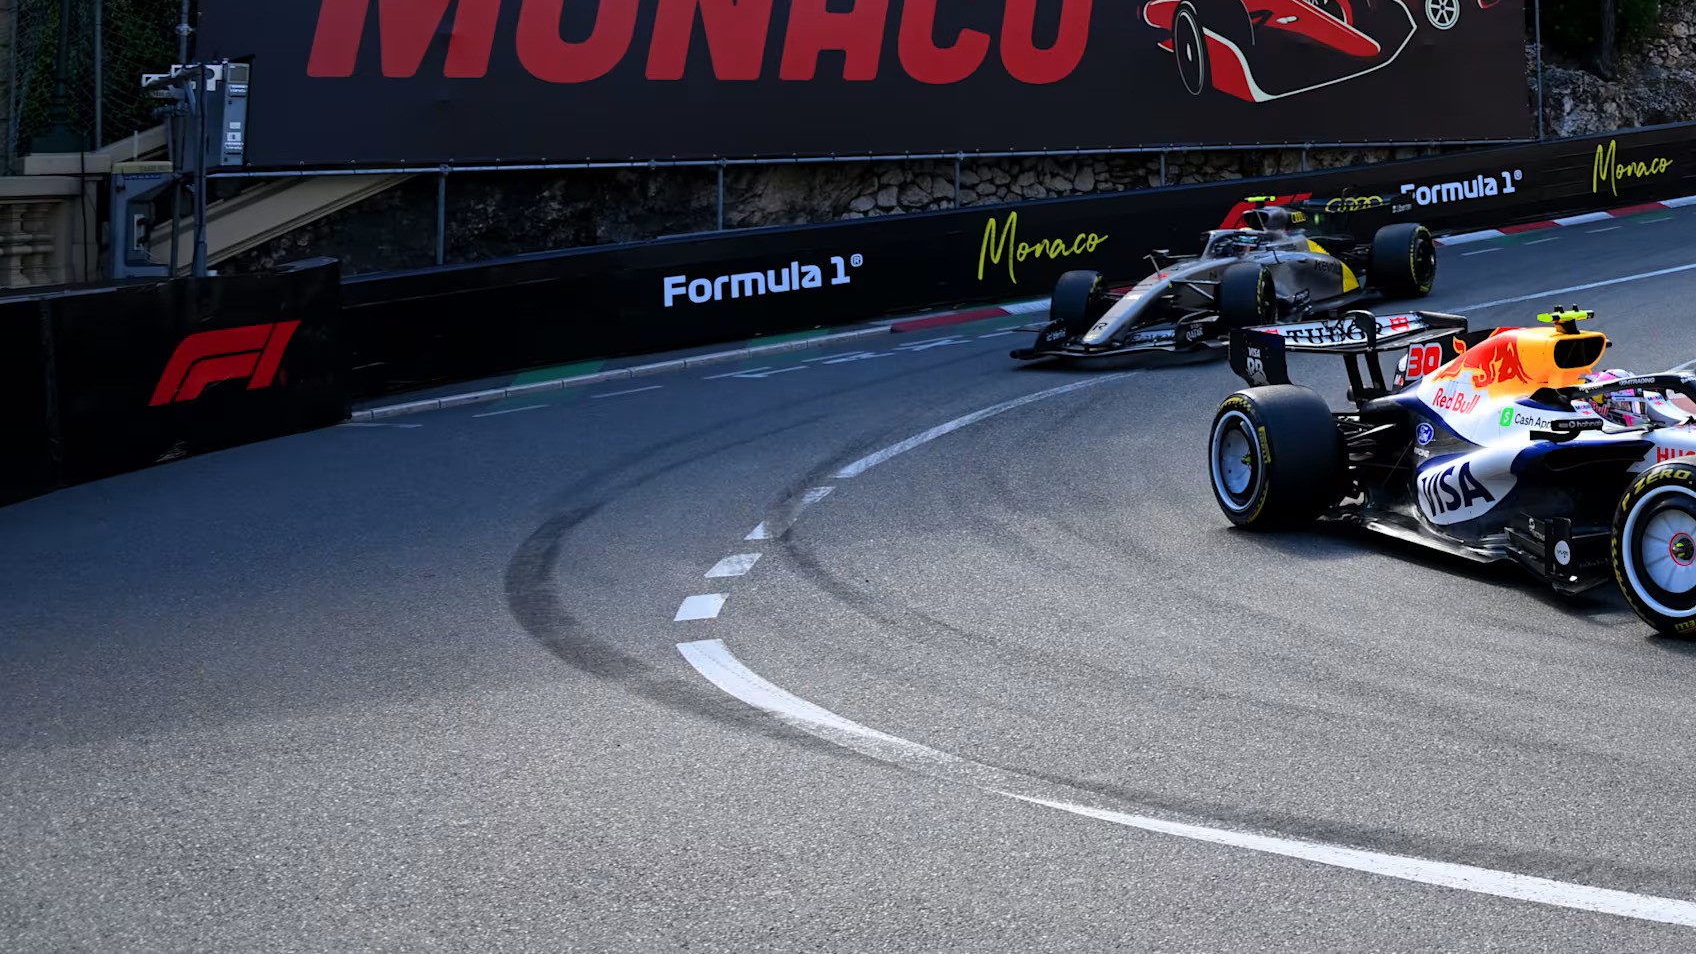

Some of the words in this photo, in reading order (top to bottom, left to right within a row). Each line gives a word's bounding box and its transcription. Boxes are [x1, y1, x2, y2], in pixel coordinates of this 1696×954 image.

[1592, 139, 1673, 197] Monaco
[978, 211, 1108, 284] Monaco
[664, 261, 822, 307] Formula
[1406, 344, 1442, 379] 30
[1433, 387, 1452, 410] Red
[1452, 392, 1481, 415] Bull
[1514, 413, 1533, 427] Cash
[1422, 461, 1495, 517] VISA
[1634, 469, 1692, 495] ZERO
